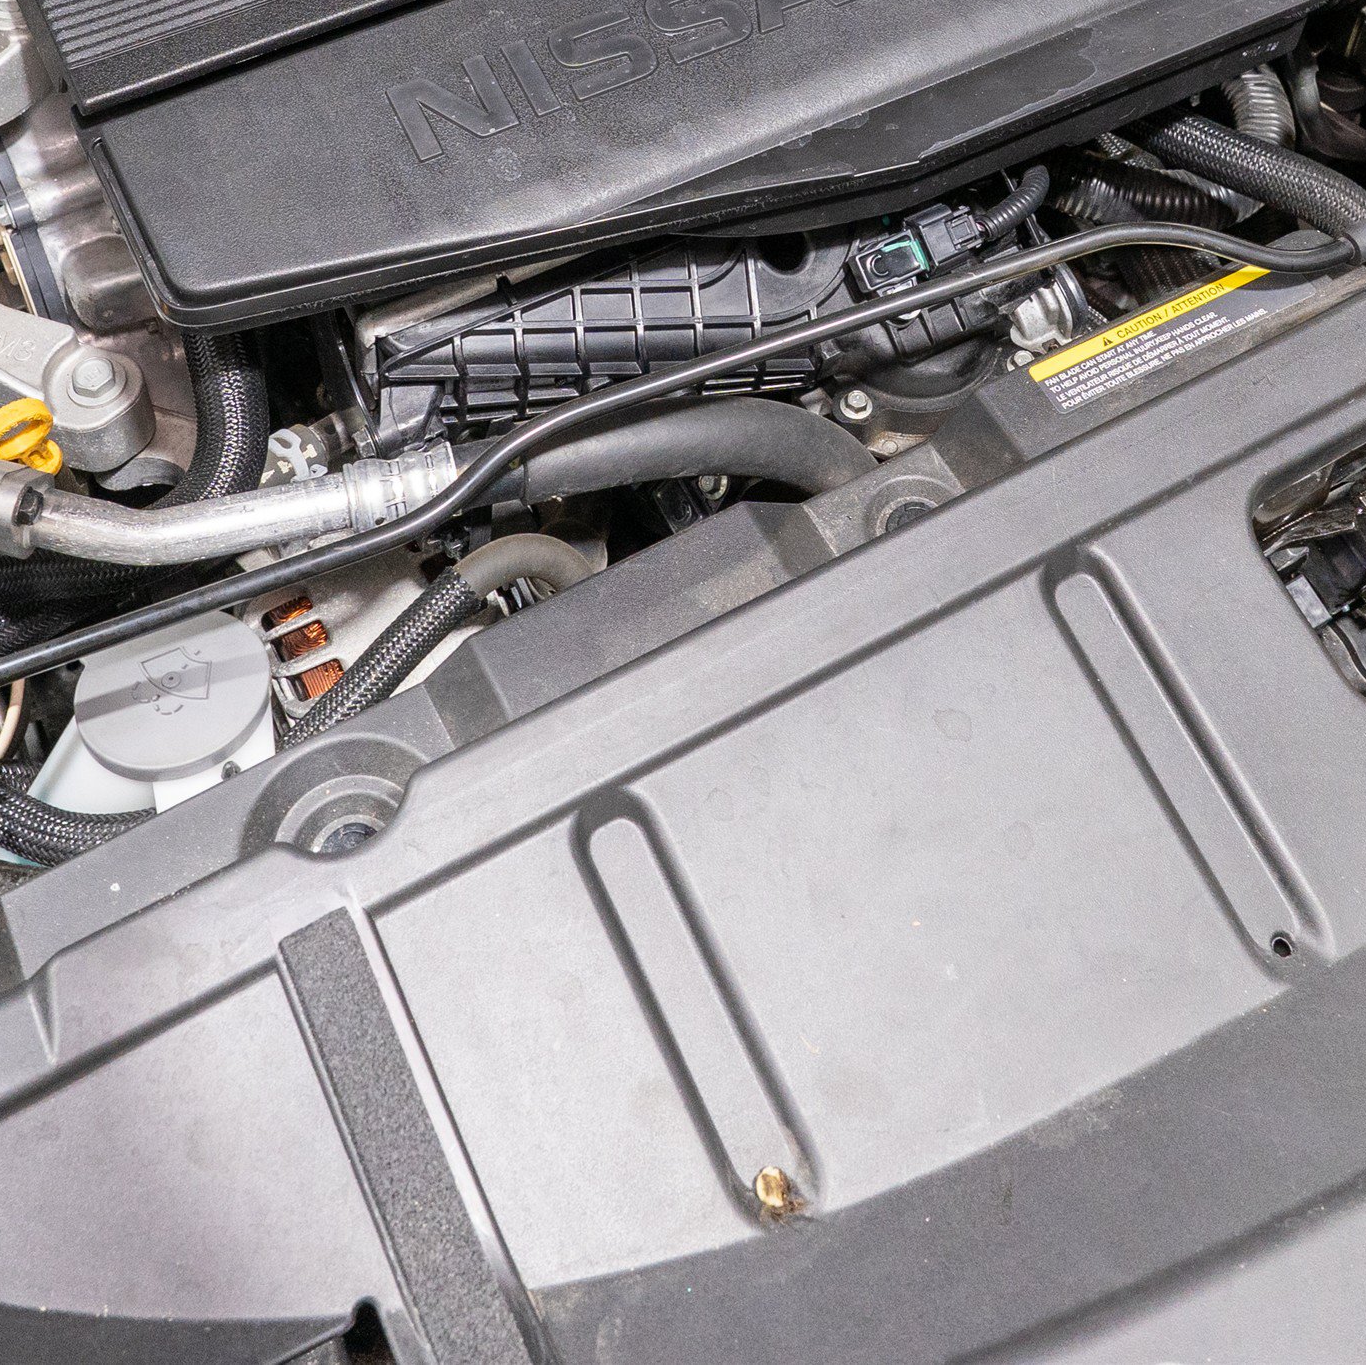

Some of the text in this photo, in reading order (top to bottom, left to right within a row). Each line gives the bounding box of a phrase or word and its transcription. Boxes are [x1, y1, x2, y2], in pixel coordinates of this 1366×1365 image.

[1117, 313, 1161, 338] CAUTION
[1171, 283, 1225, 312] ATTENTION
[1045, 331, 1157, 385] FAN BLADE CAN START AT ANY TIME.
[1051, 385, 1061, 394] TO
[1061, 377, 1079, 388] HELP
[1078, 367, 1099, 380] AVOID
[1099, 351, 1134, 370] PERSONAL
[1172, 322, 1195, 335] HANDS
[1195, 312, 1217, 325] CLEAR.
[1056, 394, 1066, 402] LE
[1066, 374, 1108, 396] VENTILATEUR
[1108, 362, 1133, 377] RISQUE
[1133, 357, 1143, 366] DE
[1142, 339, 1178, 360] DÉMARRER
[1183, 330, 1200, 341] TOUT
[1200, 317, 1230, 333] MOMENT.
[1063, 396, 1082, 408] POUR
[1081, 383, 1105, 398] ÉVITER
[1104, 374, 1127, 388] TOUTE
[1162, 353, 1172, 361] NE
[1172, 347, 1185, 356] PAS
[1185, 342, 1195, 351] EN
[1195, 324, 1234, 345] APPROCHER
[1233, 318, 1246, 327] LES
